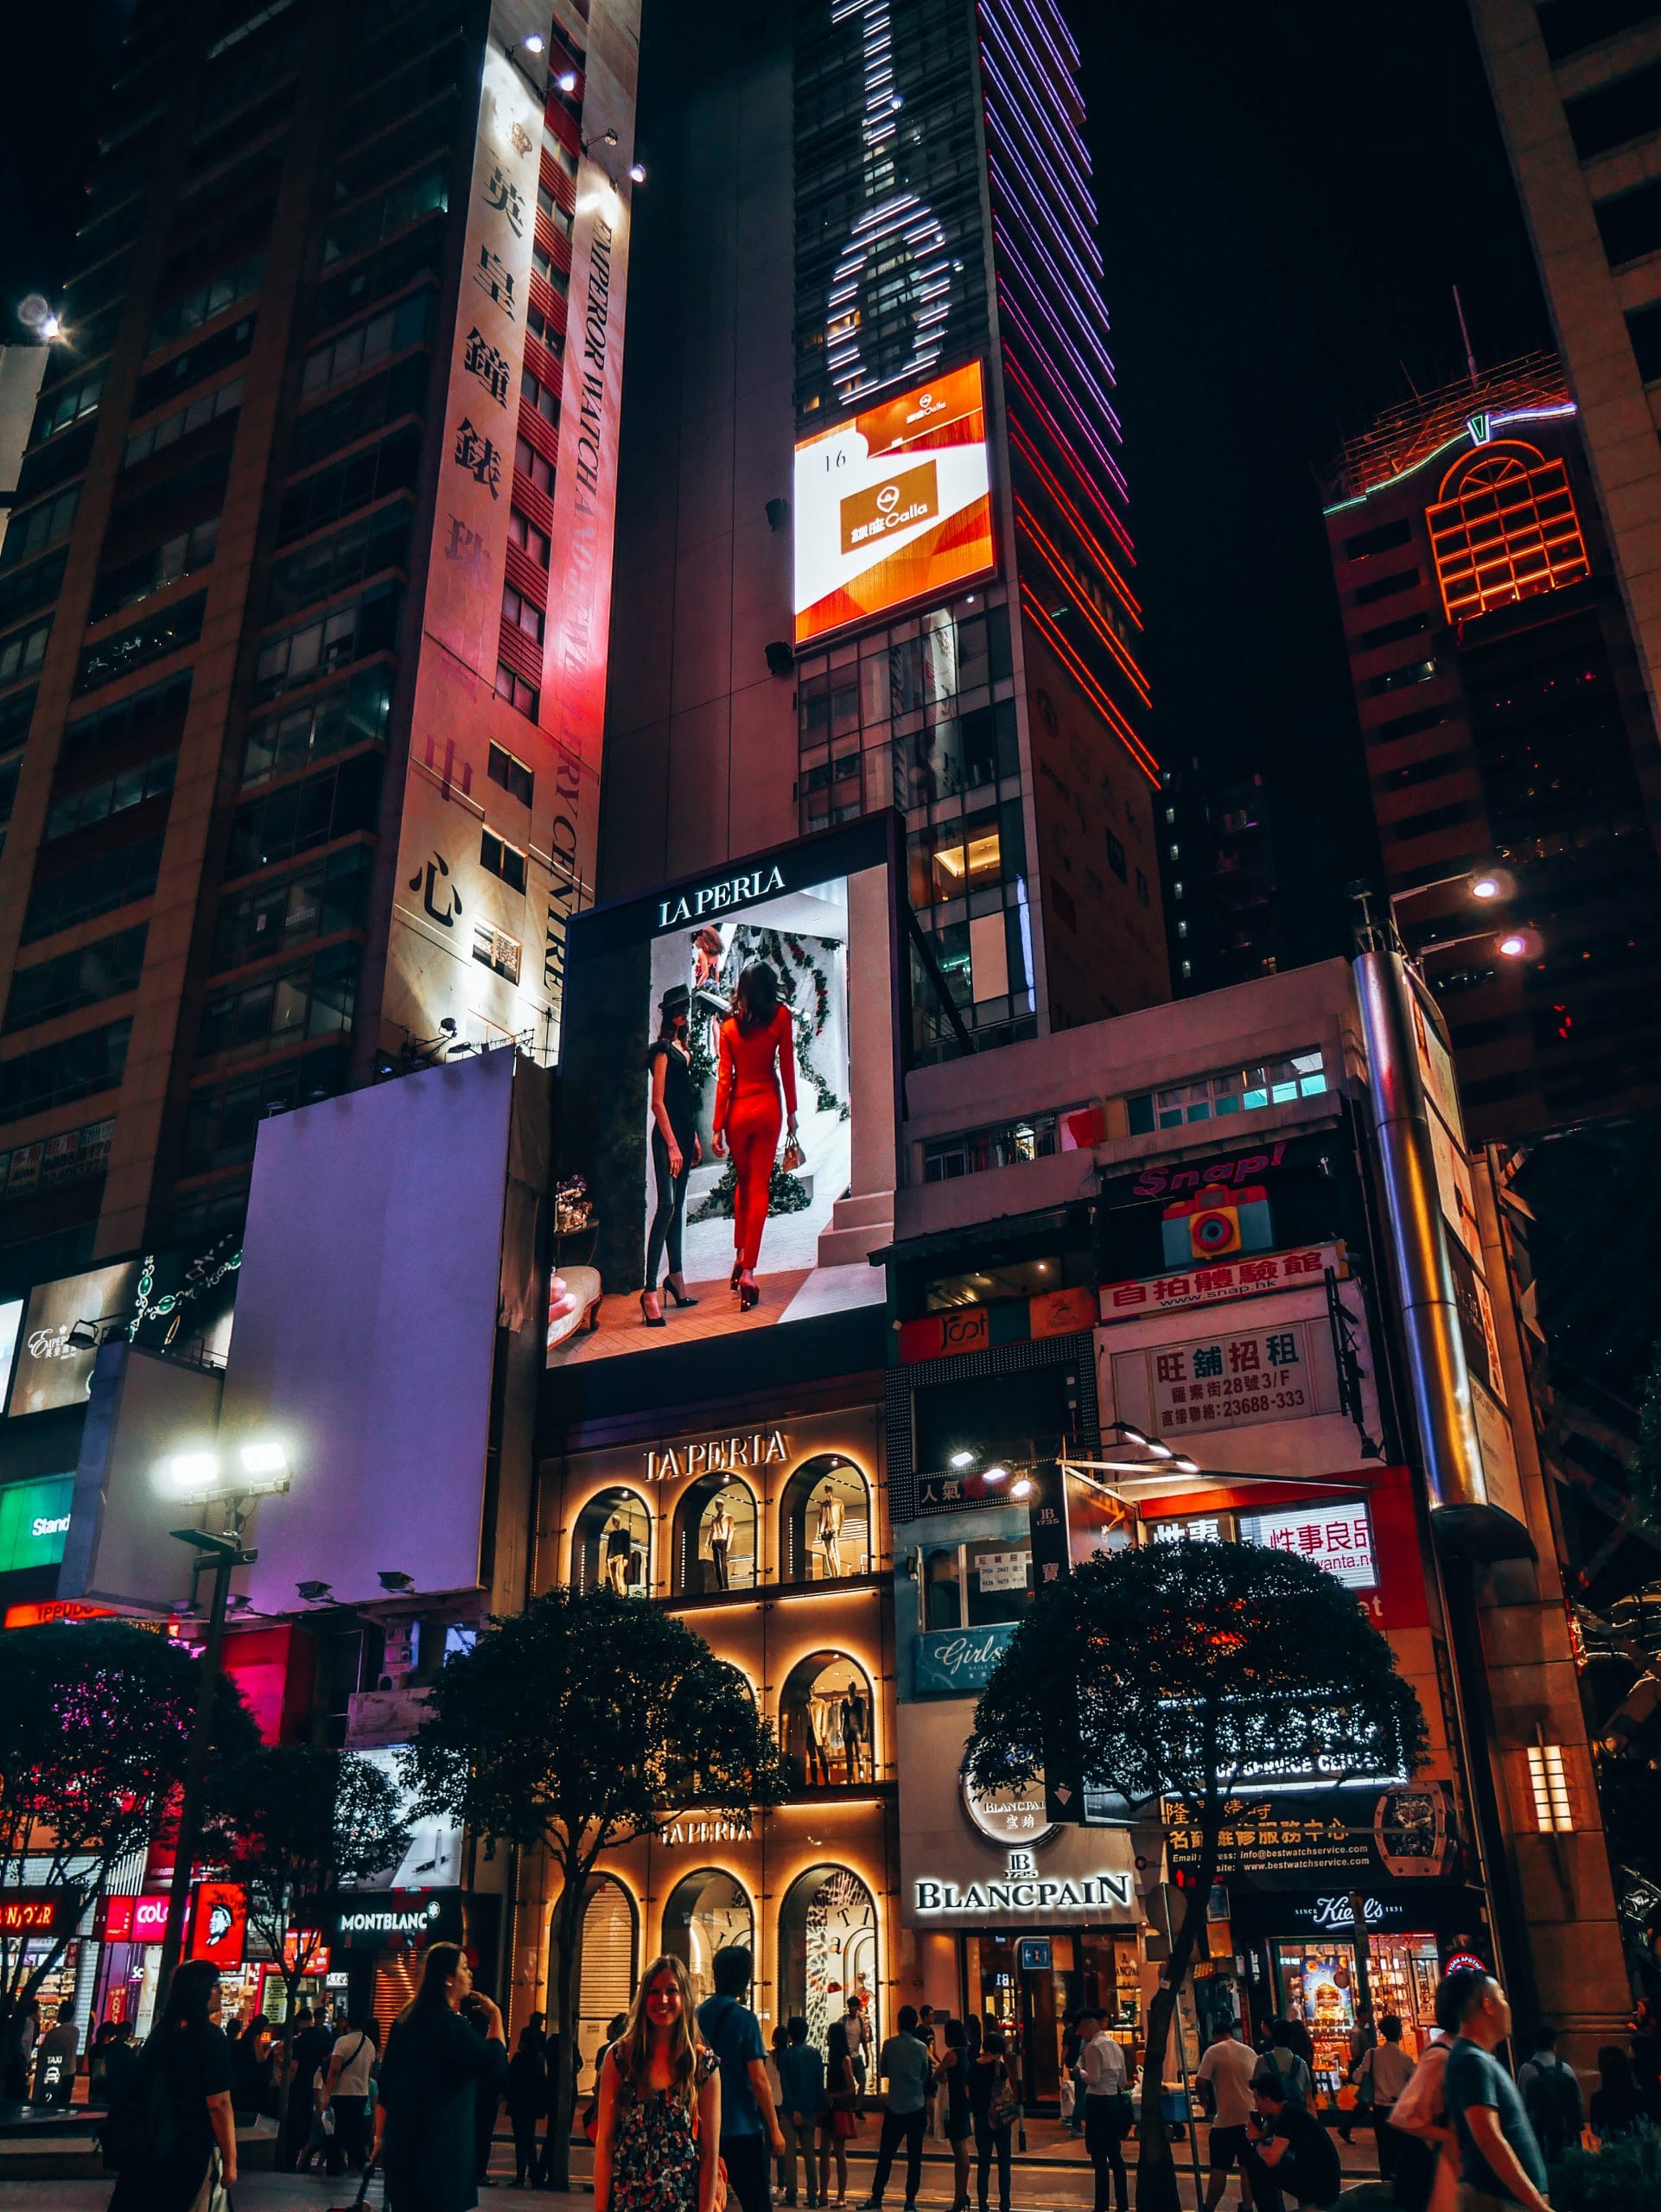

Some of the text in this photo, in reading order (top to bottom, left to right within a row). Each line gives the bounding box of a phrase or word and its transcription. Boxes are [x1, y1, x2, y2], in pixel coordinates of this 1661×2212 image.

[582, 218, 614, 370] EMPEROR
[576, 372, 606, 496] WATCH
[409, 137, 525, 929] 英皇鐘錶珠中心
[659, 866, 786, 927] LA PERLA
[1134, 1141, 1287, 1195] Snap!
[1113, 1251, 1323, 1307] 自拍體驗館
[1160, 1279, 1277, 1307] www.snap.hk
[643, 1430, 788, 1482] LA PERLA
[1240, 1845, 1368, 1859] info@bestwatchservice.com
[1244, 1858, 1370, 1871] www.bestwatchservice.com
[915, 1875, 1129, 1910] BLANCPAIN
[1313, 1896, 1383, 1923] Kiel's
[340, 1911, 428, 1931] MONTBLANC
[47, 2056, 63, 2064] TAXI
